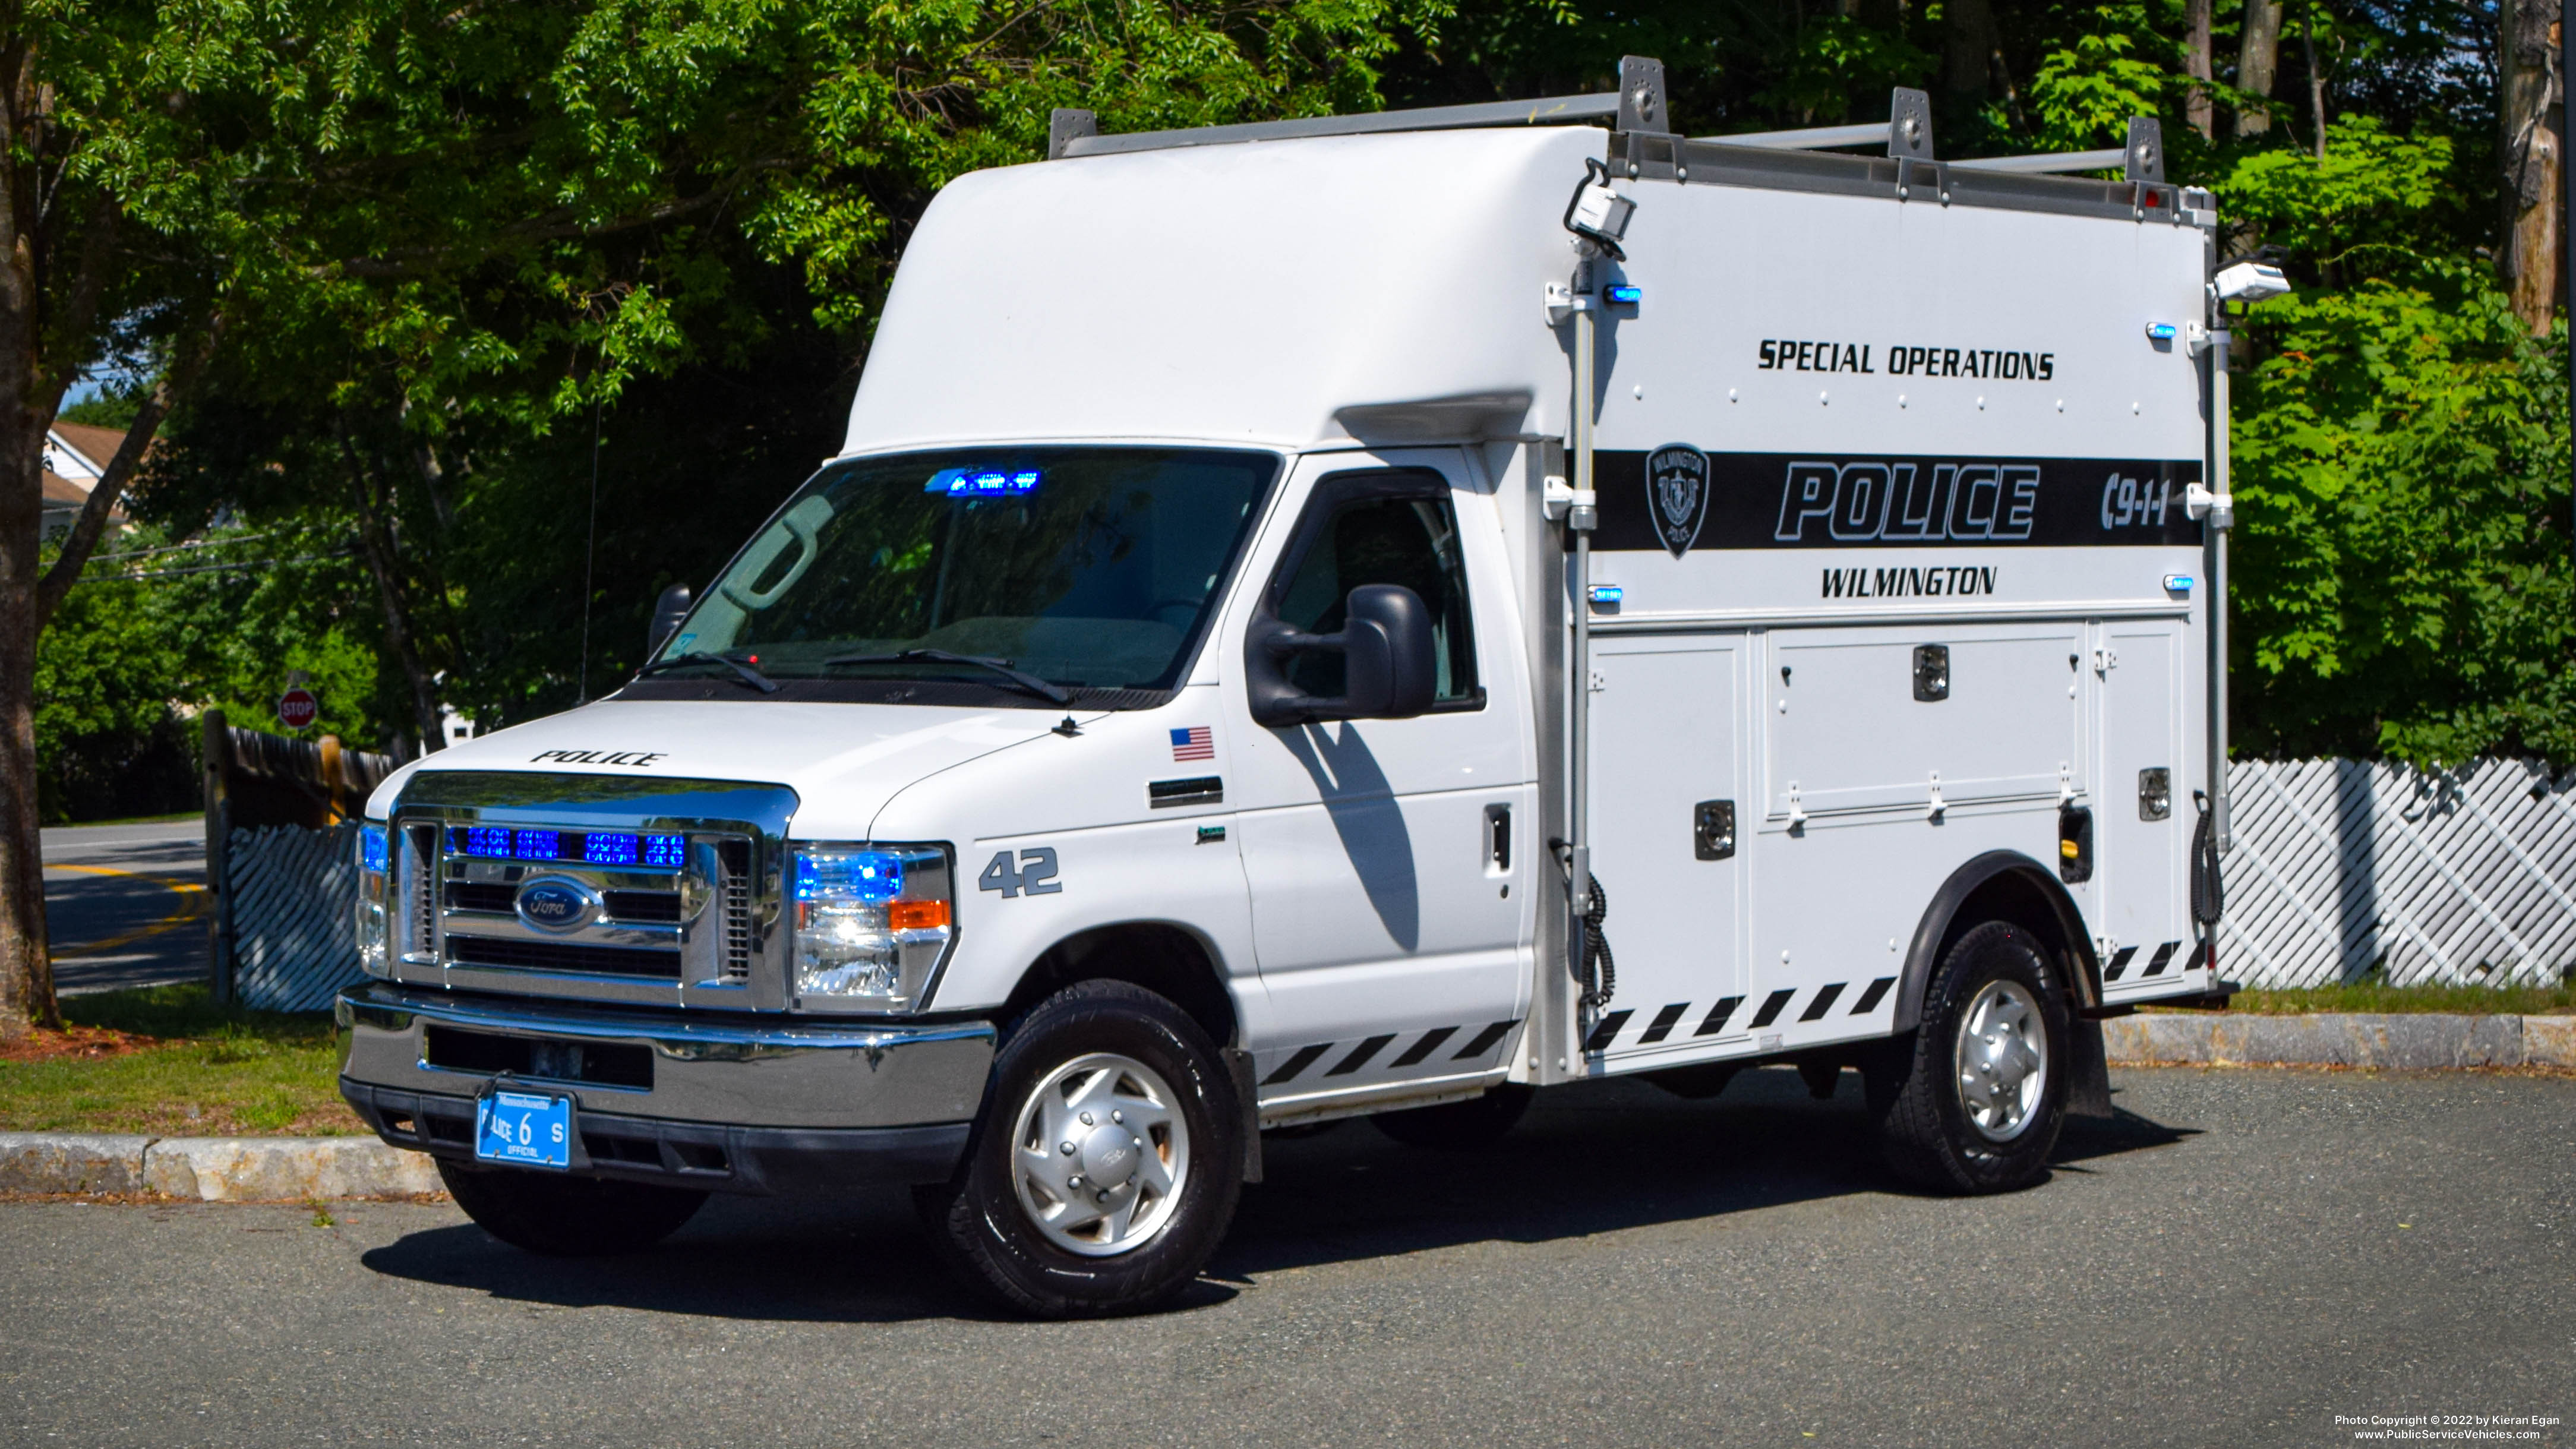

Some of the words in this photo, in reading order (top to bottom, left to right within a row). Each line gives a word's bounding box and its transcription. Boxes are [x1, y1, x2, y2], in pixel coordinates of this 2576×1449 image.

[1759, 339, 1874, 374] SPECIAL
[1888, 346, 2055, 381] OPERATIONS
[1774, 461, 2041, 541] POLICE
[2114, 478, 2171, 526] 9-1-1
[1821, 566, 1998, 599] WILMINGTON
[283, 701, 313, 716] STOP
[529, 750, 669, 767] POLICE
[978, 846, 1063, 899] 42
[530, 891, 567, 915] Ford
[519, 1112, 532, 1146] 6
[551, 1122, 564, 1143] S
[507, 1144, 539, 1158] OFFICIAL
